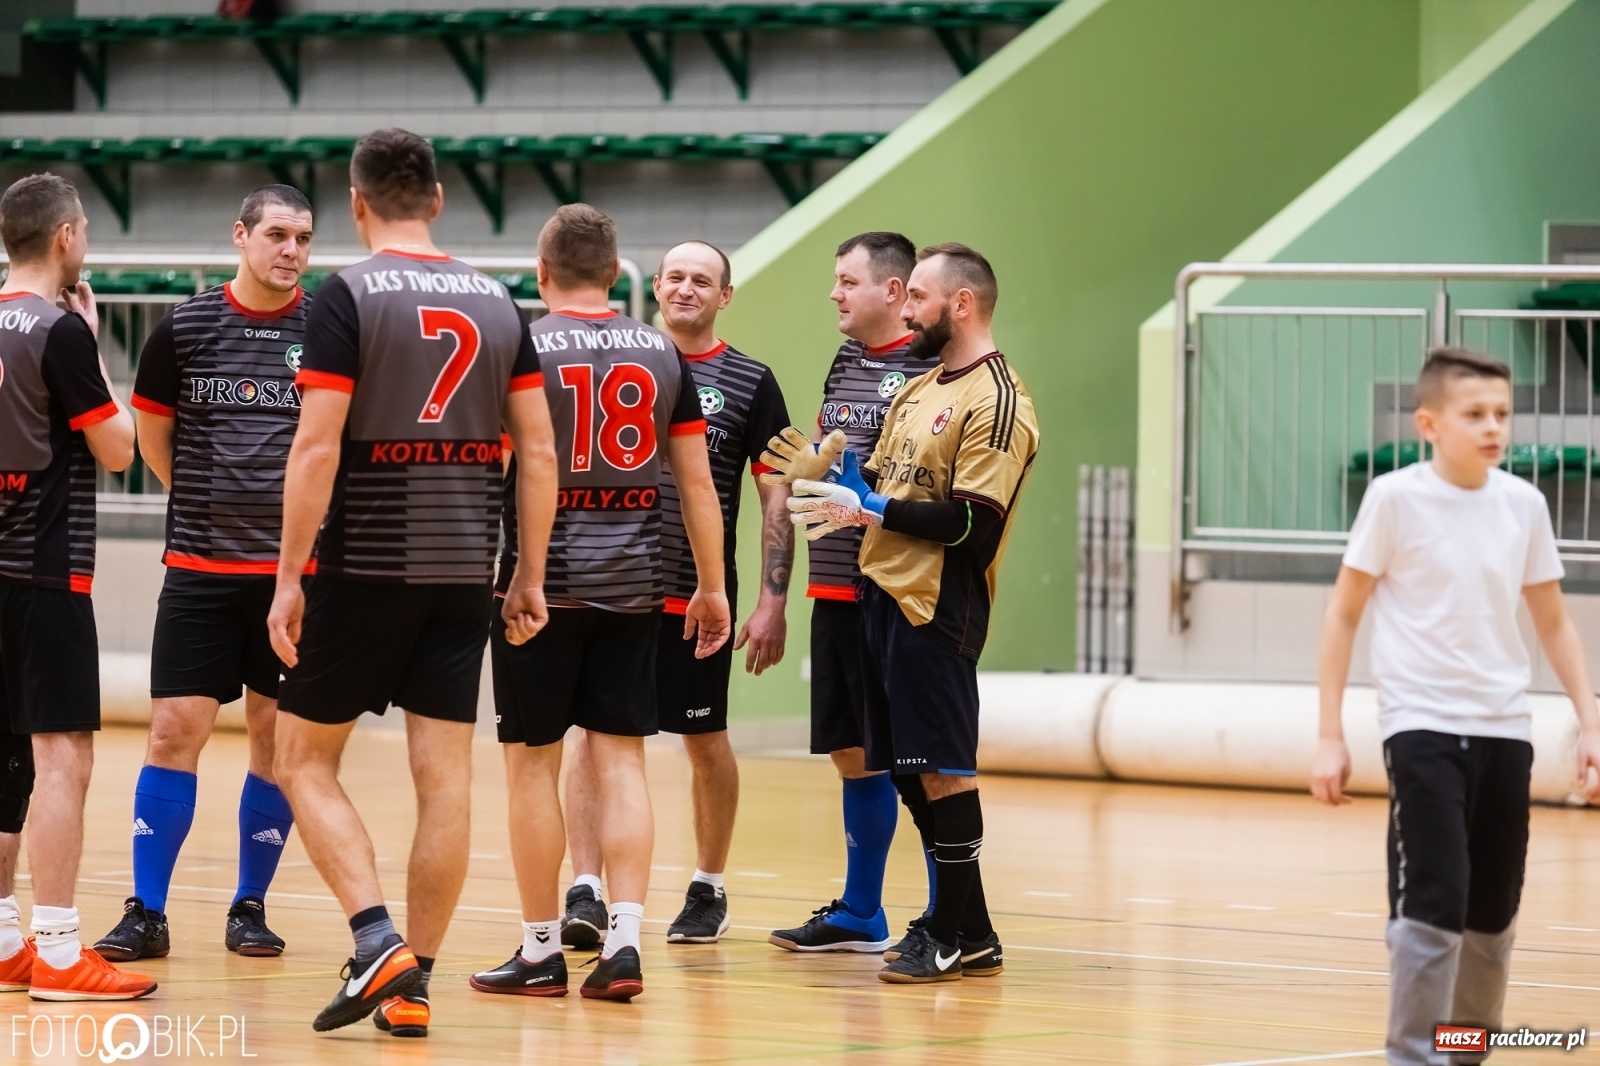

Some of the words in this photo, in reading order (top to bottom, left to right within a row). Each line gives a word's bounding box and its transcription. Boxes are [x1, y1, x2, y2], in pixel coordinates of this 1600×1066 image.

[363, 270, 403, 294] LKS
[403, 270, 504, 298] TWORKÓW
[531, 331, 568, 354] LKS
[570, 327, 665, 351] TWORKÓW
[417, 305, 482, 423] 7
[558, 362, 657, 472] 18
[252, 834, 284, 846] adidas
